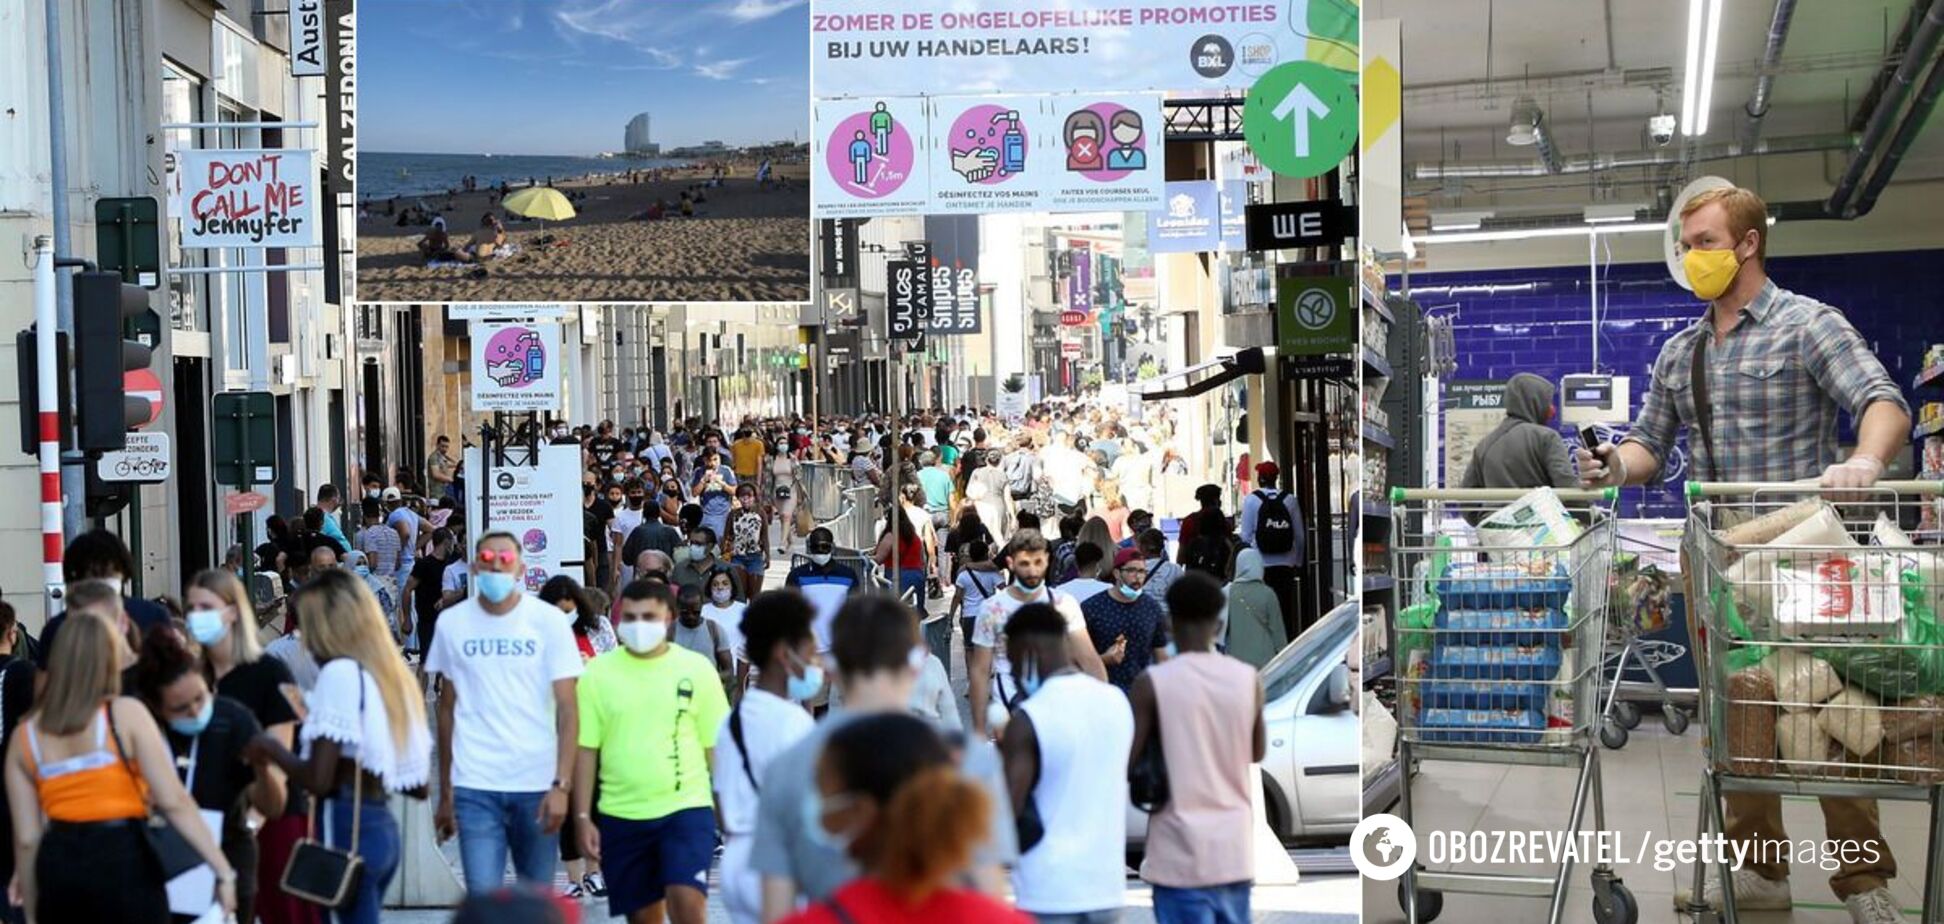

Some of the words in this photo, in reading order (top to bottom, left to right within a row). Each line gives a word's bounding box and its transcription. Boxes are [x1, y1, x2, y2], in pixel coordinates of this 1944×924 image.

[813, 14, 895, 31] ZOMER
[902, 13, 934, 30] DE
[940, 9, 1133, 29] ONGELOFELIJKE
[1139, 5, 1277, 25] PROMOTIES
[827, 41, 862, 59] BIJ
[869, 40, 910, 58] UW
[1197, 56, 1226, 68] BXL
[338, 12, 354, 181] CALZEDONIA
[208, 153, 282, 189] DON'T
[190, 189, 261, 221] CALL
[264, 181, 304, 220] ME
[994, 190, 1011, 198] VOS
[1012, 190, 1039, 198] MAINS
[192, 211, 303, 243] Jennyfer
[1272, 211, 1323, 239] WE
[1472, 394, 1502, 407] РЫБУ
[127, 436, 149, 444] CEPTE
[462, 639, 537, 658] GUESS
